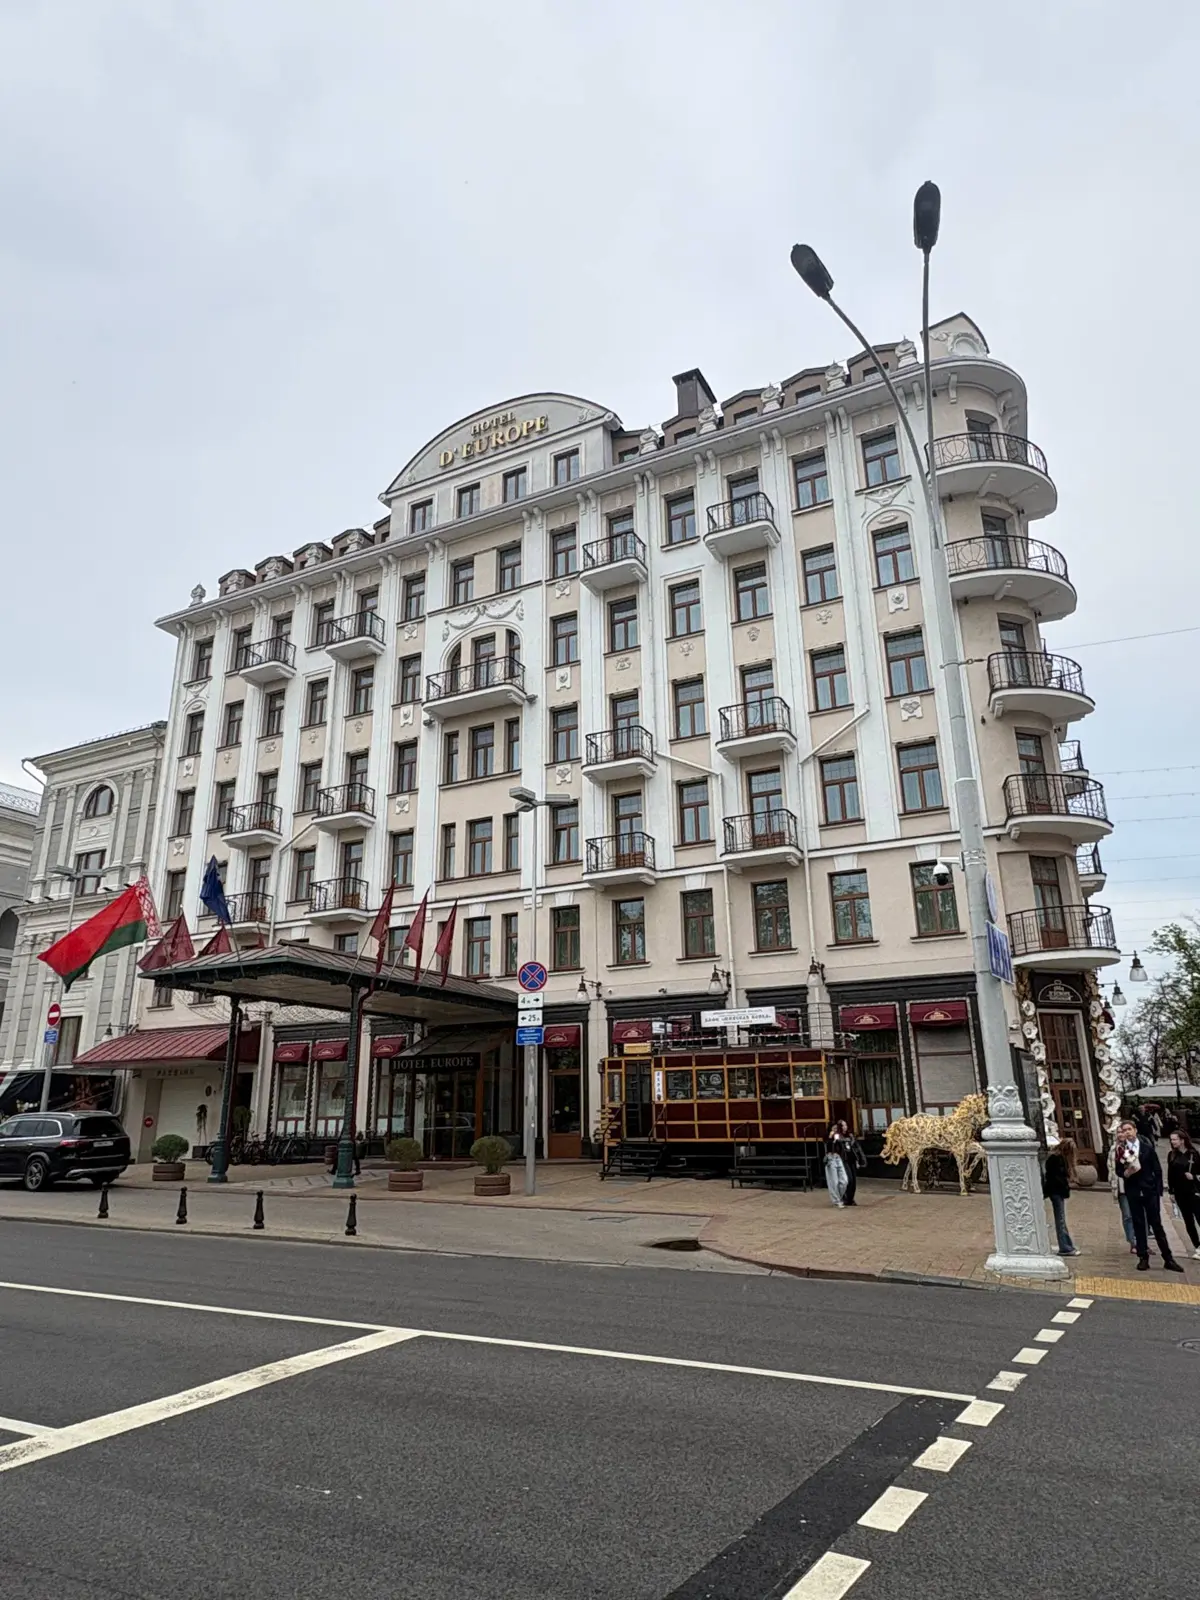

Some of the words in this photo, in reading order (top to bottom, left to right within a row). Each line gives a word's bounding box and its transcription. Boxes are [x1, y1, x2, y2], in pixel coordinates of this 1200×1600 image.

[471, 412, 516, 435] HOTEL
[439, 414, 548, 467] D'EUROPE
[393, 1060, 425, 1070] HOTEL
[431, 1056, 474, 1069] EUROPE
